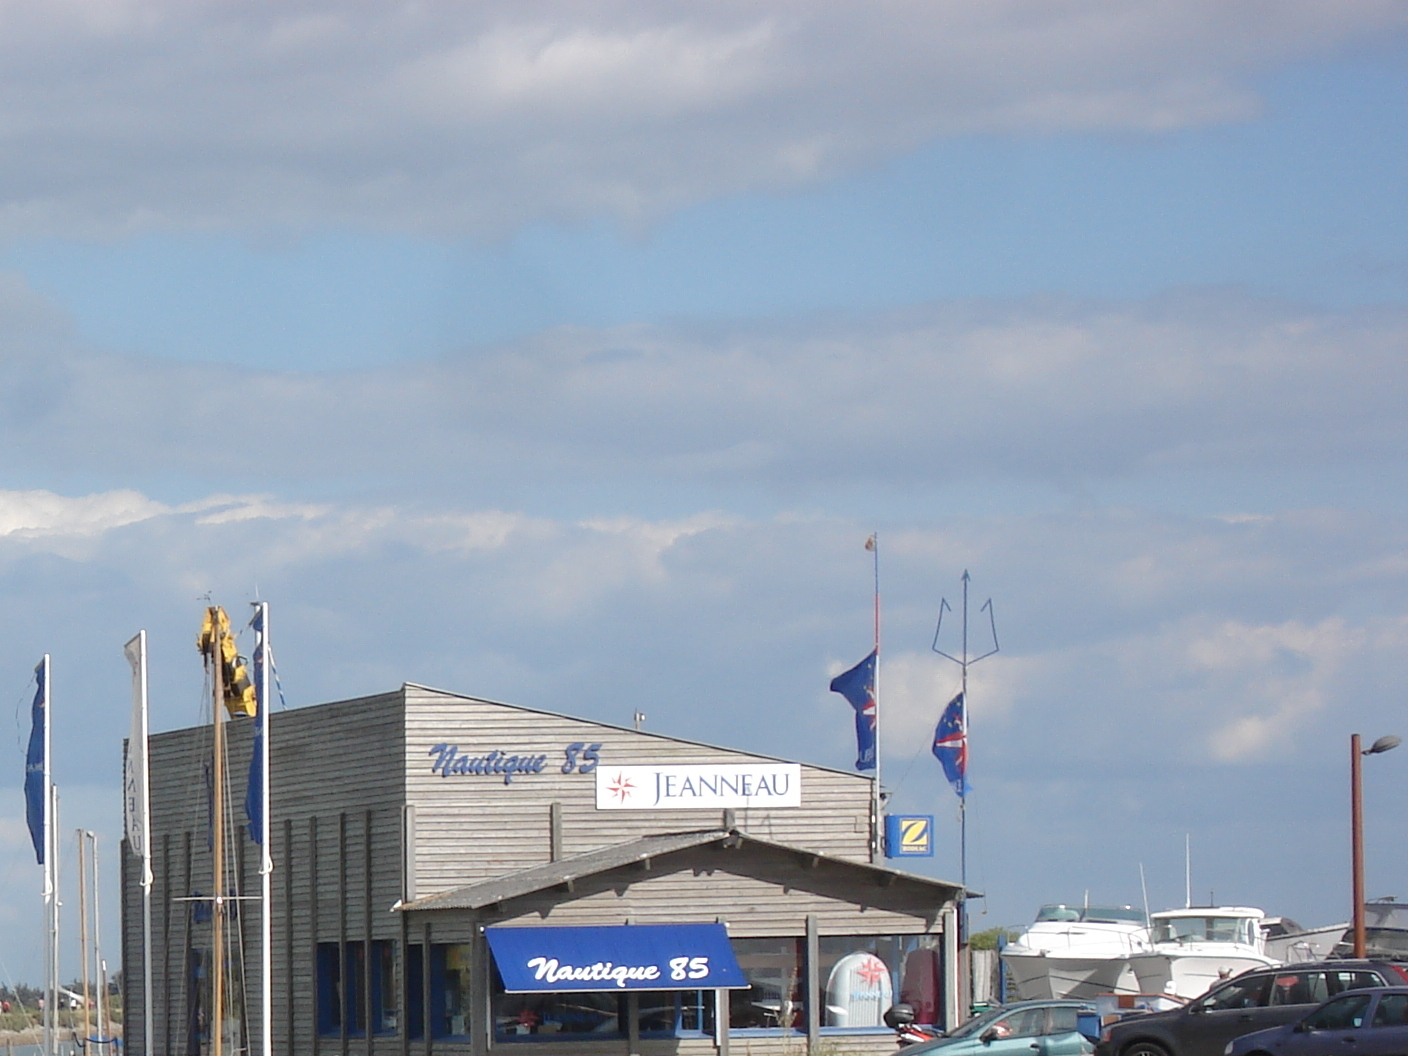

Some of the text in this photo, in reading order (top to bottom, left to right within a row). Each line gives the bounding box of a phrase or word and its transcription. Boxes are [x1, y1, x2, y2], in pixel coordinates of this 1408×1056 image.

[429, 742, 603, 785] Nautique 85
[653, 772, 790, 806] JEANNEAU
[527, 956, 709, 988] Nautique 85
